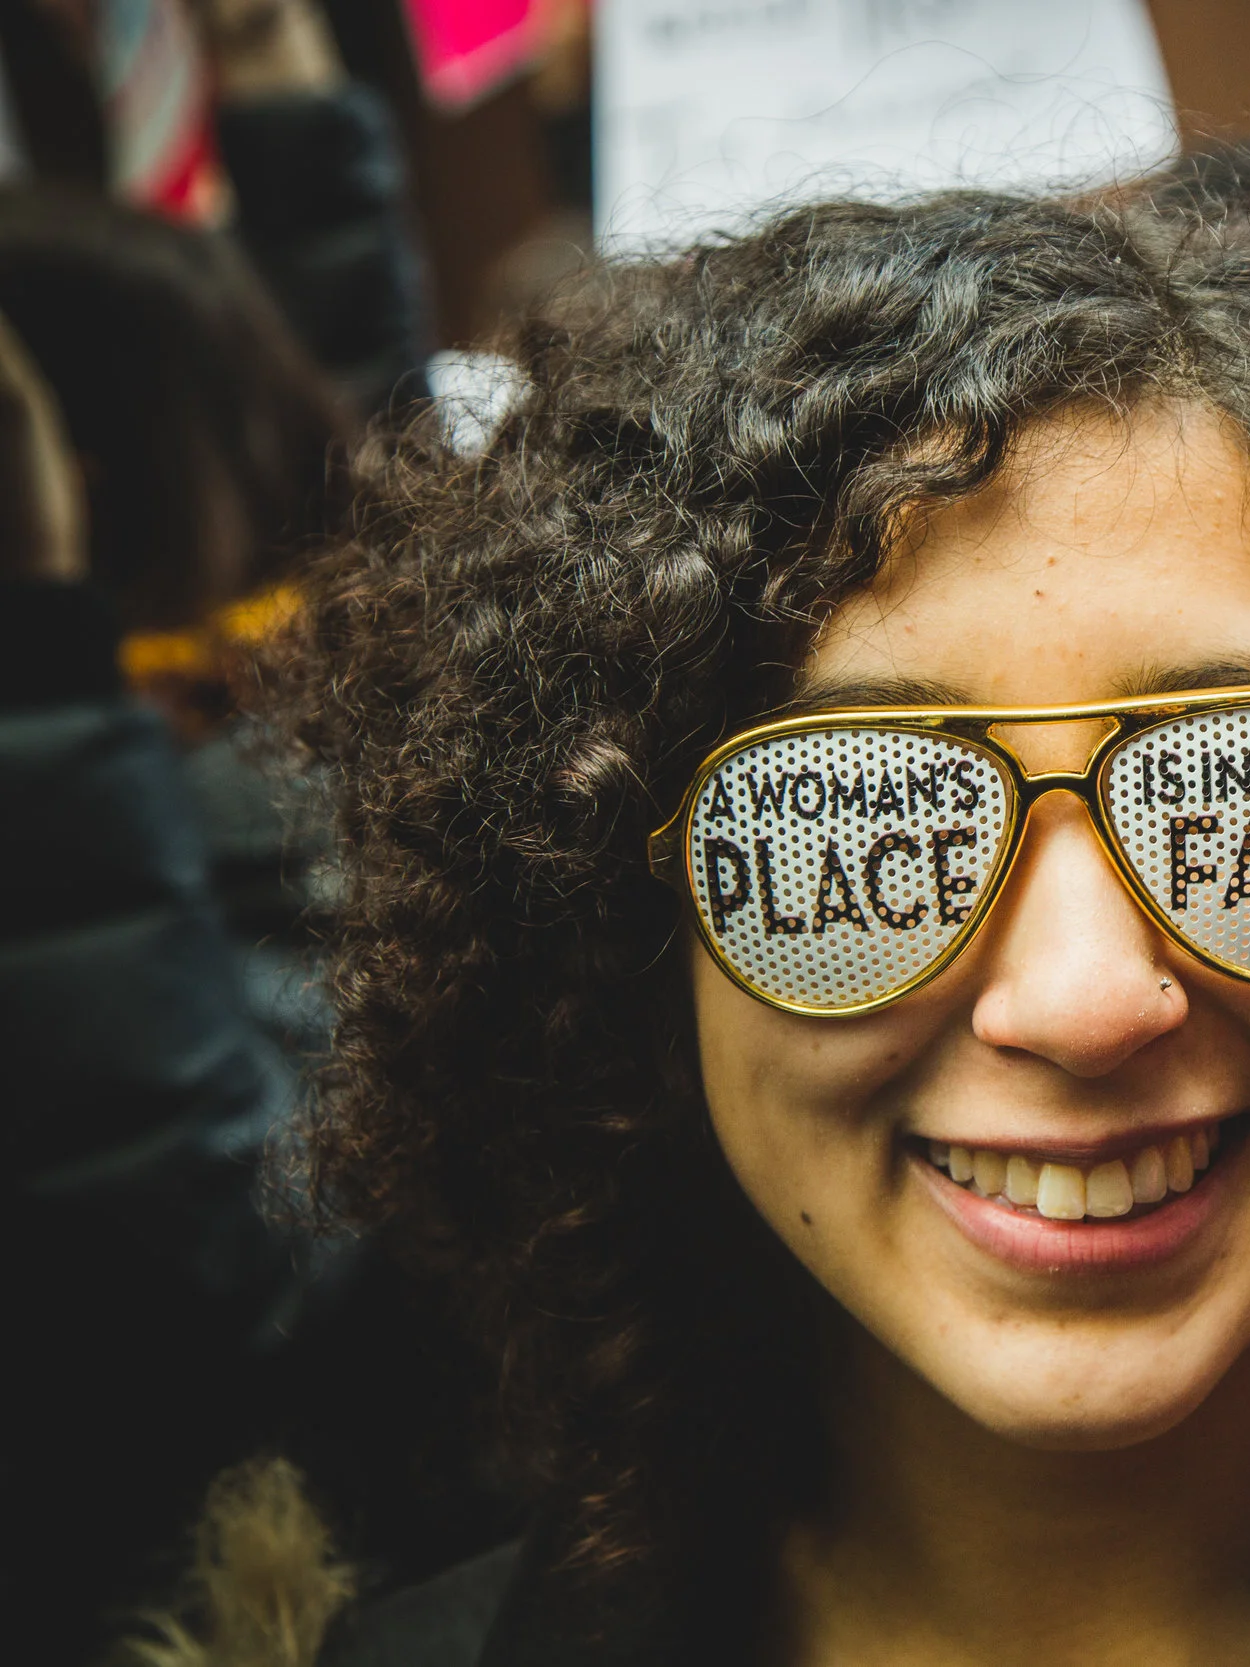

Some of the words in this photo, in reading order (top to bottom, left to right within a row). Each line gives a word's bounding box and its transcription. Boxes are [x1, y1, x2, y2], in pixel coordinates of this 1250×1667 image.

[707, 771, 736, 821] A
[746, 761, 979, 820] WOMAN'S
[1142, 753, 1186, 805] IS
[704, 827, 977, 934] PLACE
